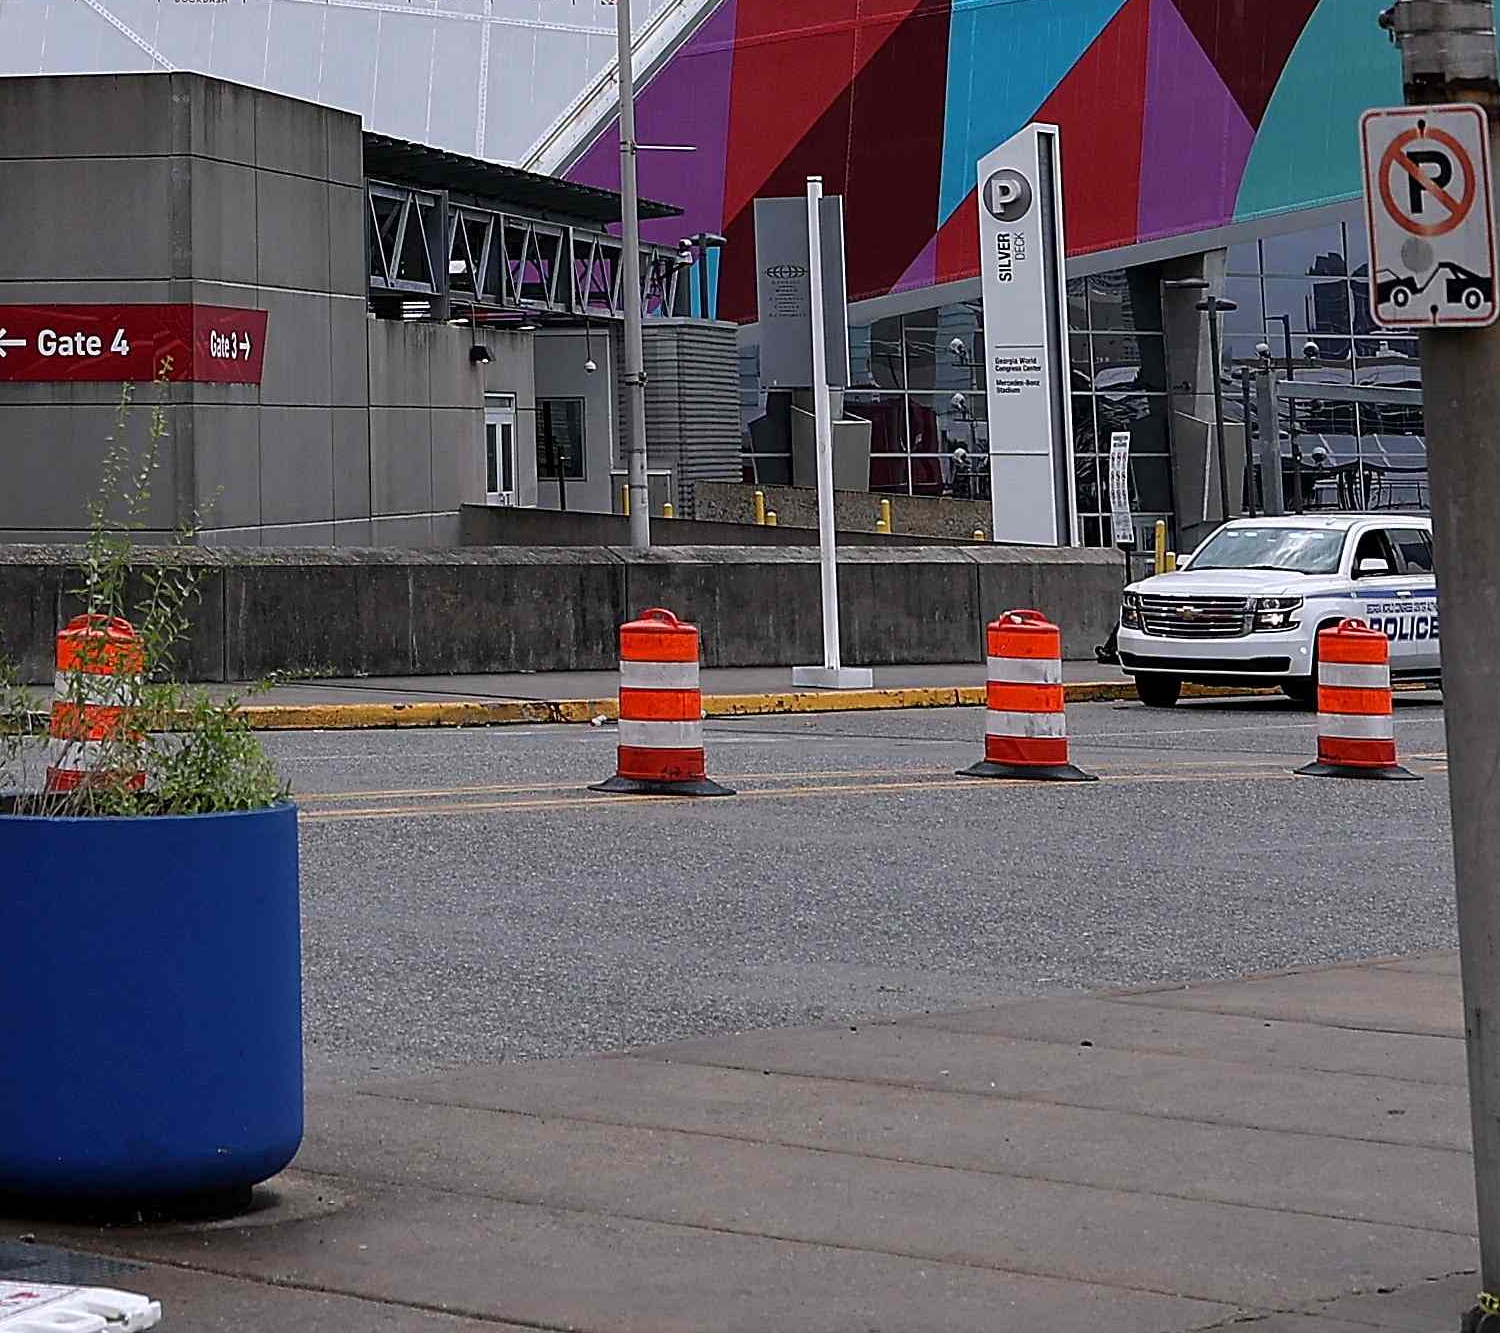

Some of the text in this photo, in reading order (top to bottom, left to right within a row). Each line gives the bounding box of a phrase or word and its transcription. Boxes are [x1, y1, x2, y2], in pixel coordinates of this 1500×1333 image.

[991, 179, 1021, 213] P
[997, 233, 1012, 282] SILVER
[1015, 232, 1025, 261] DECK
[37, 328, 130, 356] Gate 4
[210, 330, 238, 359] Gate 3
[1370, 616, 1440, 641] POLICE
